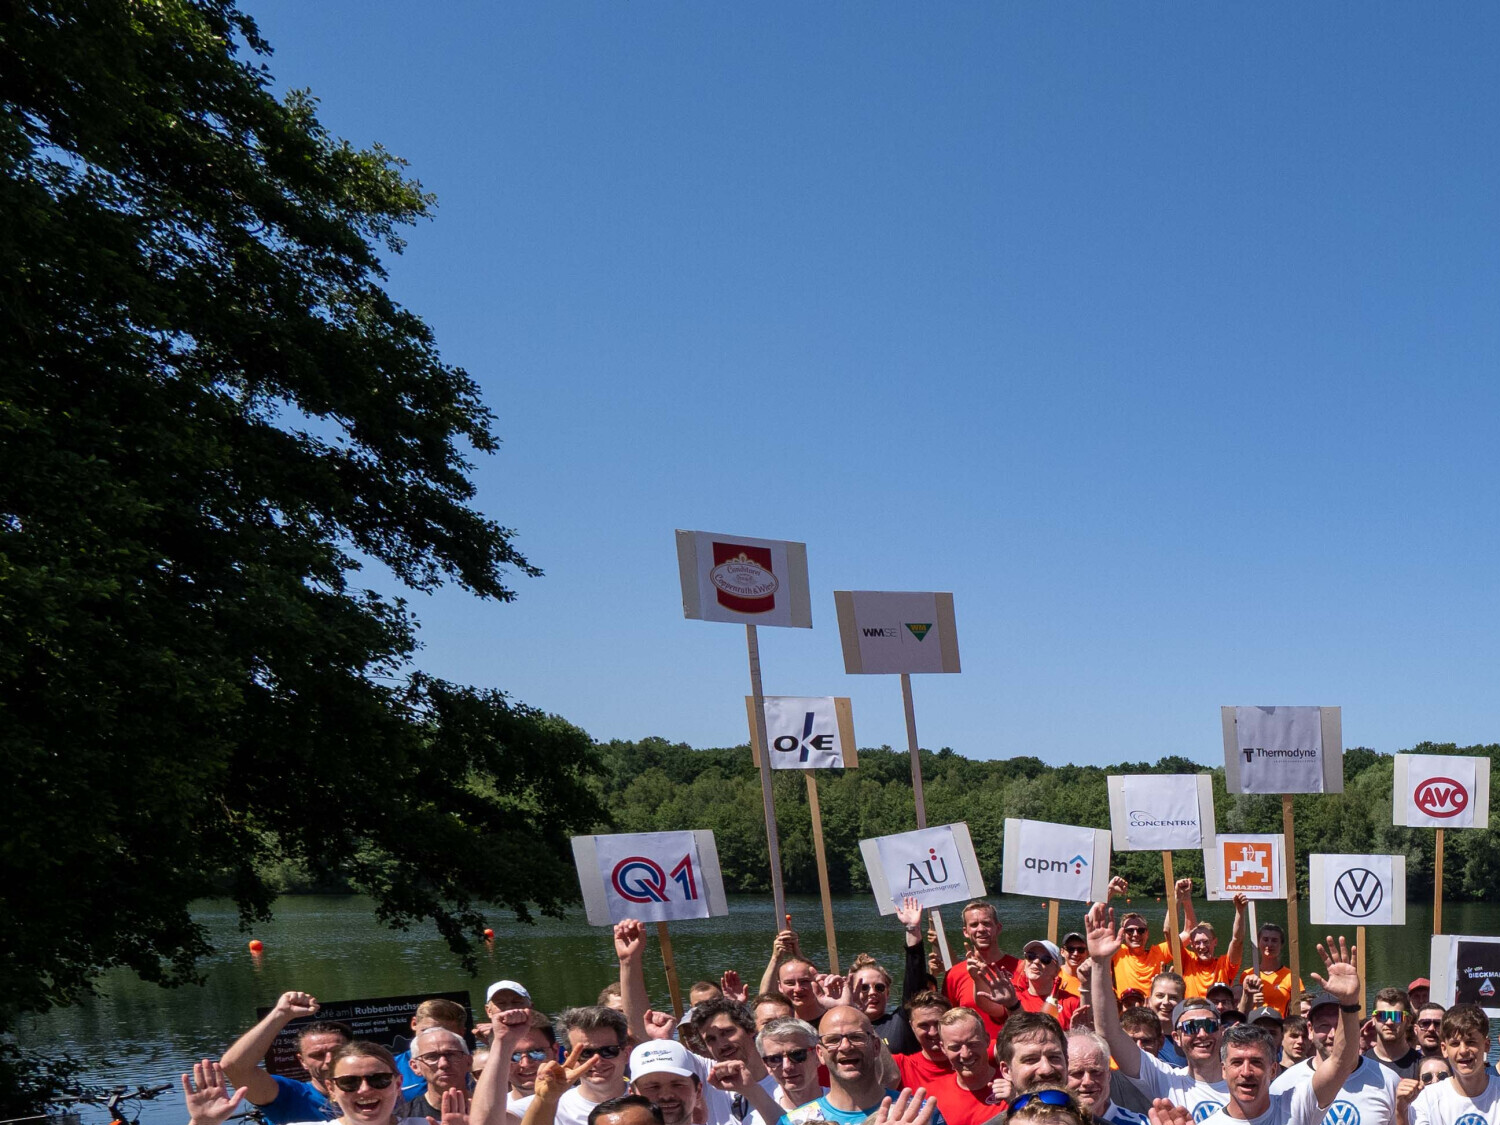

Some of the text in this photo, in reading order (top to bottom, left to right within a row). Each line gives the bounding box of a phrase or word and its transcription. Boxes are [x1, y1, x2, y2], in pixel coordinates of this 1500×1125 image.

[774, 712, 834, 762] OKE
[1256, 748, 1316, 760] Thermodyne
[1419, 785, 1469, 810] AVO
[1024, 857, 1068, 874] apm
[611, 853, 699, 904] Q1
